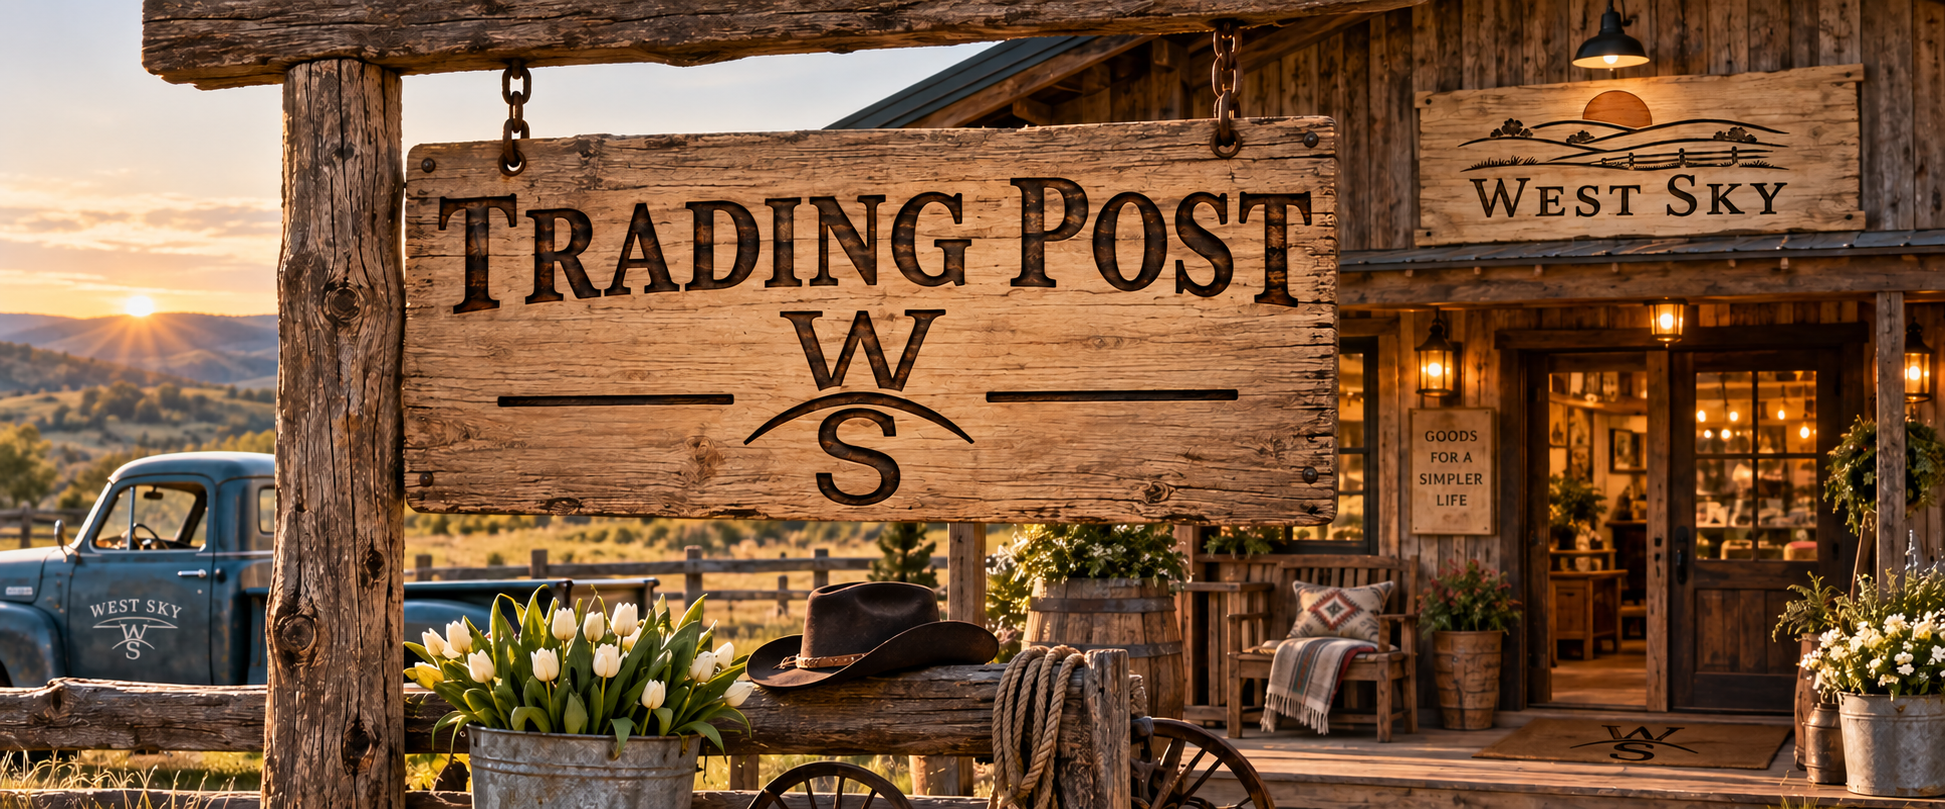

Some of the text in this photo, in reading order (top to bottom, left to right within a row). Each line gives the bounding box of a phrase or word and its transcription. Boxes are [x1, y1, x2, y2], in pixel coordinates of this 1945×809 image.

[1469, 174, 1788, 218] WEST SKY
[438, 177, 1312, 315] TRADING POST
[1425, 430, 1478, 442] GOODS
[1430, 451, 1473, 463] FOR A
[1419, 473, 1483, 485] SIMPLER
[1436, 494, 1468, 506] LIFE
[90, 598, 182, 619] WEST SKY
